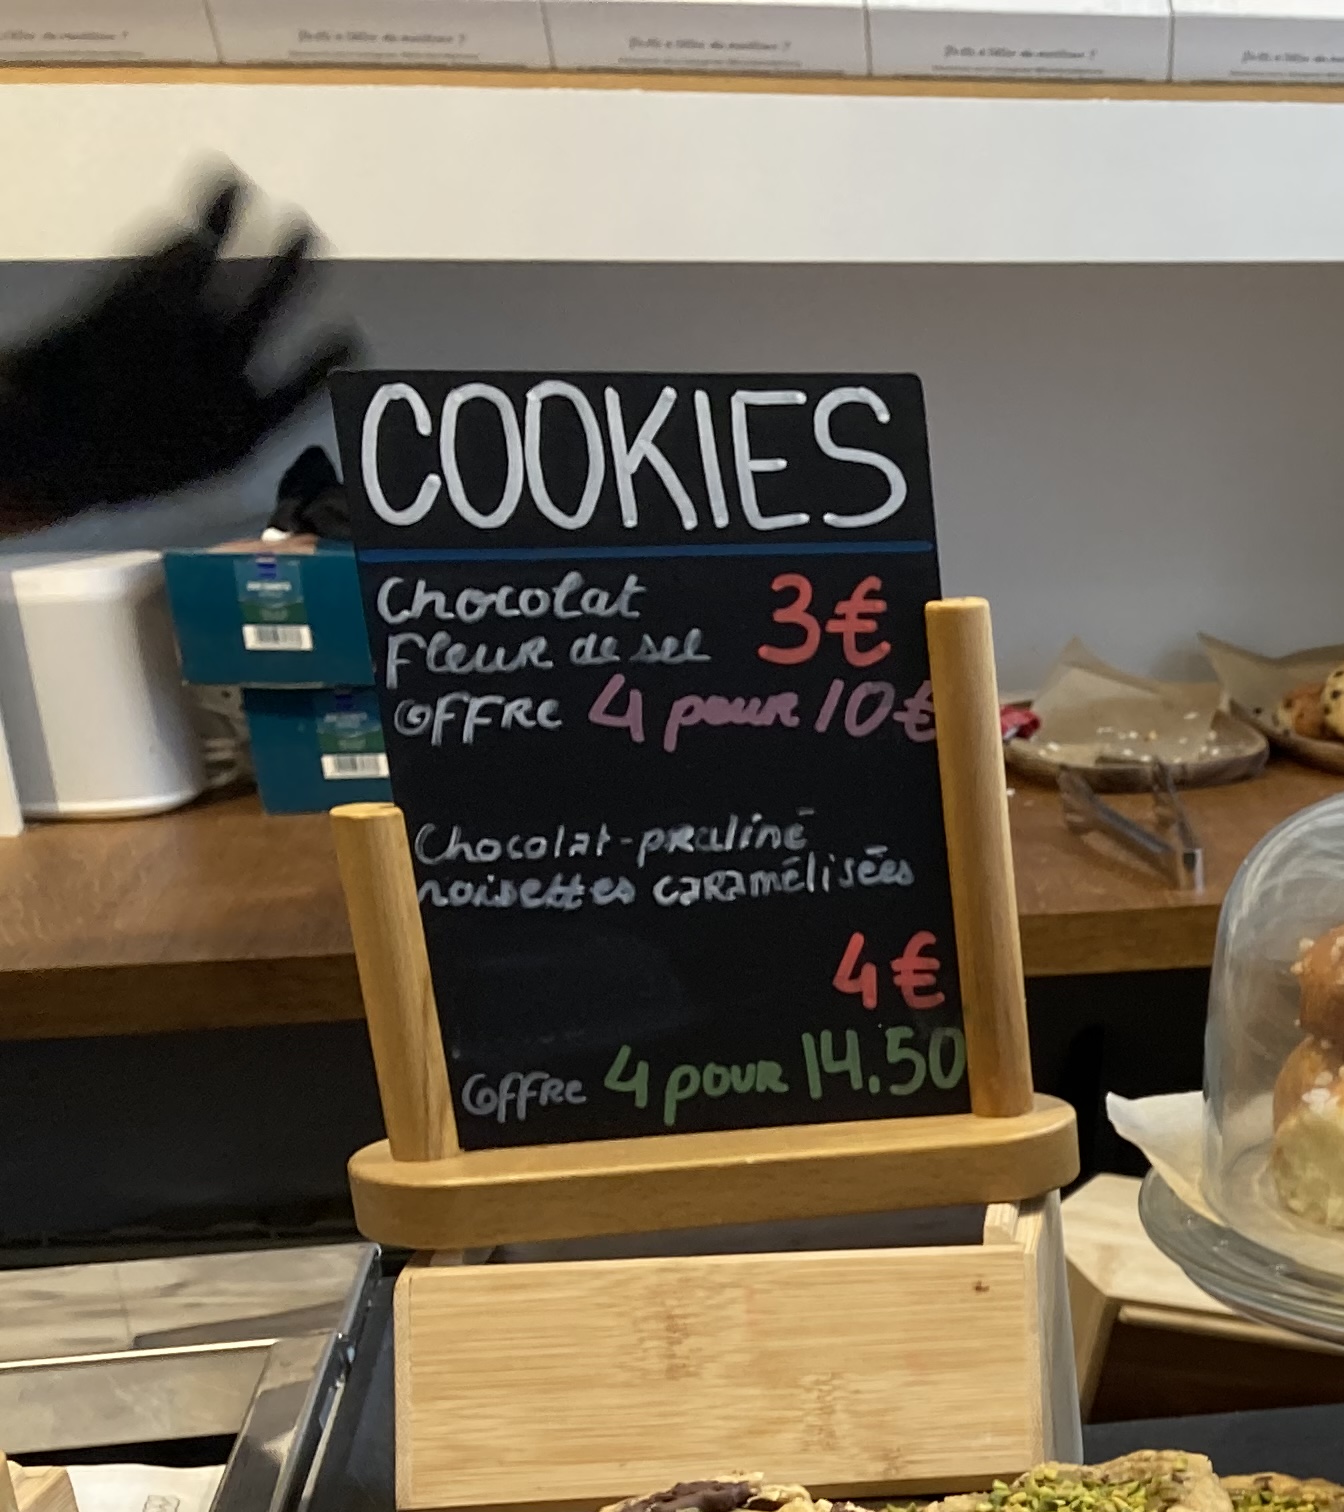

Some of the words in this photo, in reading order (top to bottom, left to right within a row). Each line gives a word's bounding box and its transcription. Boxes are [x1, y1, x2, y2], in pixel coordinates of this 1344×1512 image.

[362, 381, 906, 529] COOKIES
[377, 571, 647, 625] Chocolat
[758, 573, 891, 668] 3€
[570, 632, 620, 664] de
[630, 628, 711, 663] sel
[588, 674, 645, 743] 4
[417, 875, 636, 910] noisettes
[832, 931, 945, 1010] 4€
[603, 1044, 648, 1109] 4
[801, 1026, 965, 1100] 14.50
